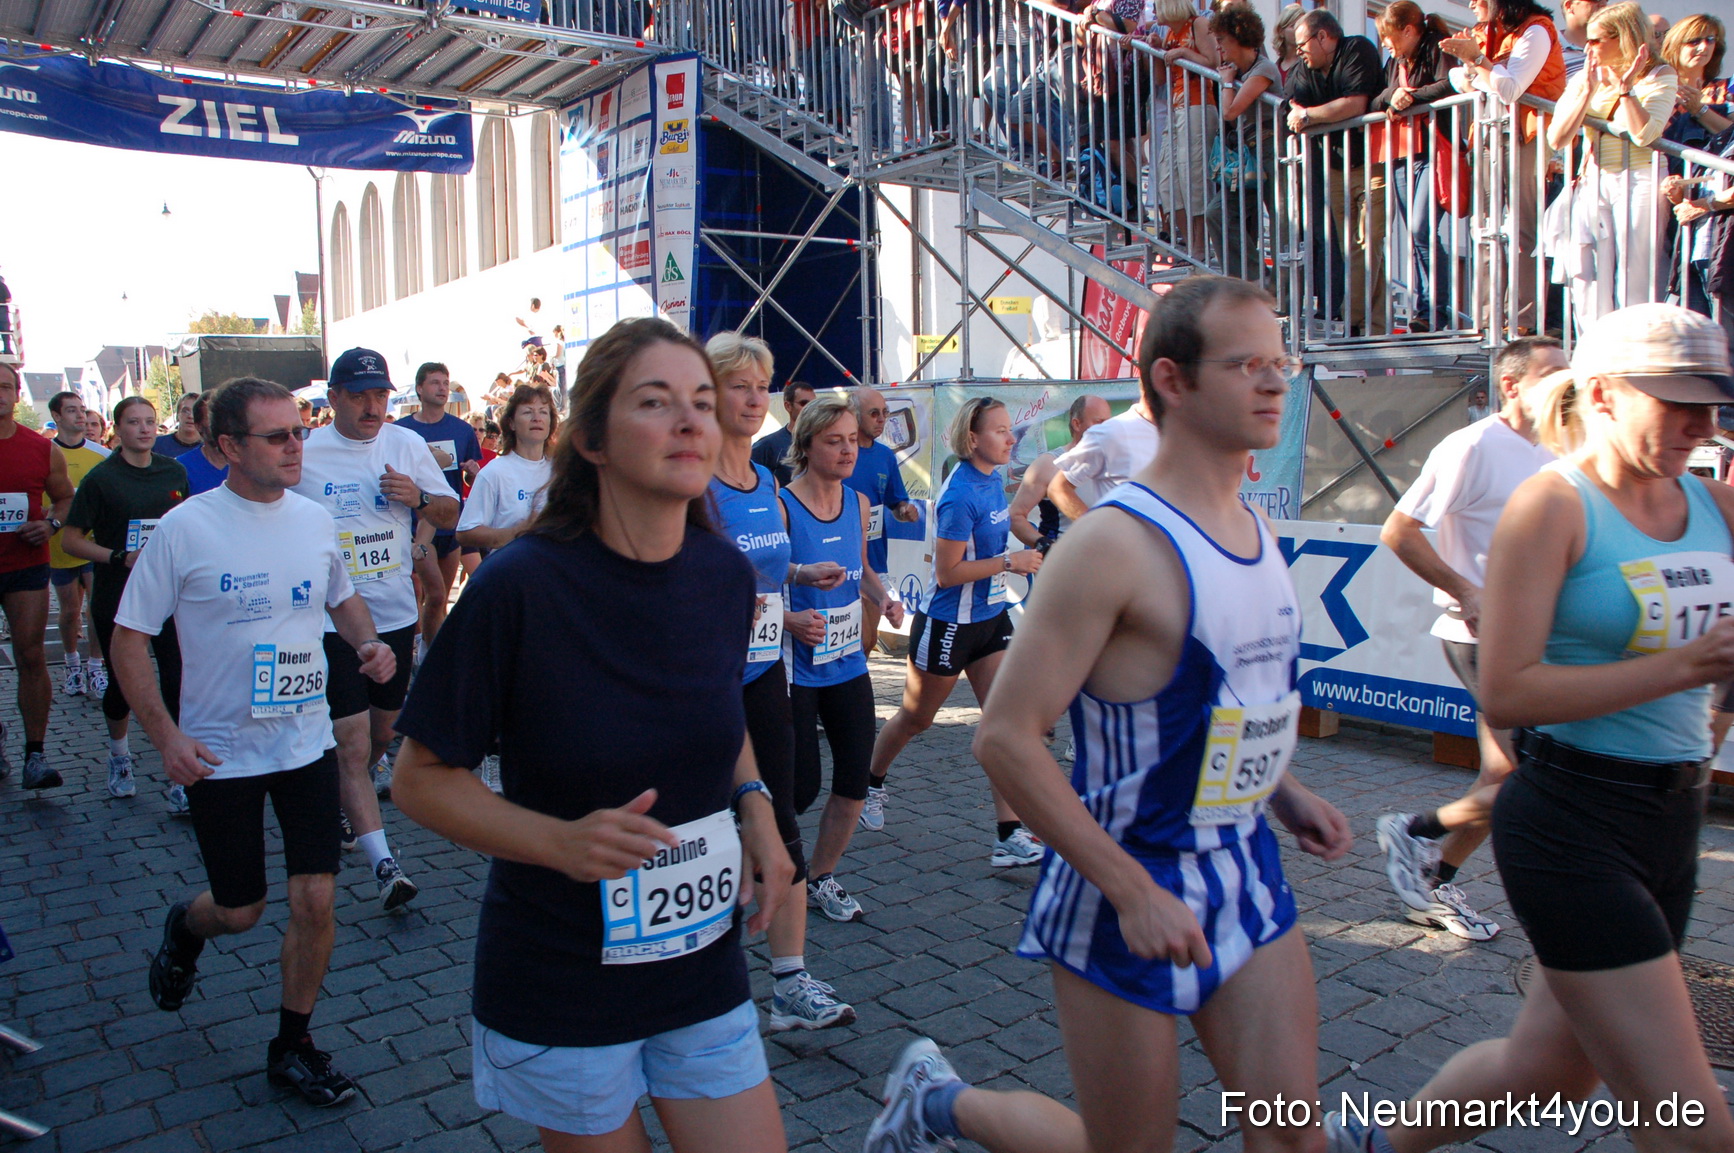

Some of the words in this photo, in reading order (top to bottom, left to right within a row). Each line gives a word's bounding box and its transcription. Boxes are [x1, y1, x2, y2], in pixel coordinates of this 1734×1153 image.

[0, 108, 48, 121] urope.com
[158, 94, 299, 146] ZIEL
[393, 130, 456, 145] MIZUNO
[1115, 301, 1133, 342] Ostbaye
[1015, 391, 1050, 425] Leben
[354, 530, 394, 545] Reinhold
[343, 551, 351, 560] B
[359, 548, 391, 567] 184
[220, 573, 238, 593] 6.
[233, 572, 269, 583] Neumarkter
[829, 612, 851, 625] Agnes
[1647, 602, 1664, 621] C
[829, 622, 860, 647] 2144
[278, 651, 311, 665] Dieter
[259, 671, 269, 683] C
[278, 670, 323, 696] 2256
[1211, 752, 1226, 771] C
[1234, 748, 1281, 790] 597
[612, 887, 628, 908] C
[648, 867, 733, 927] 2986
